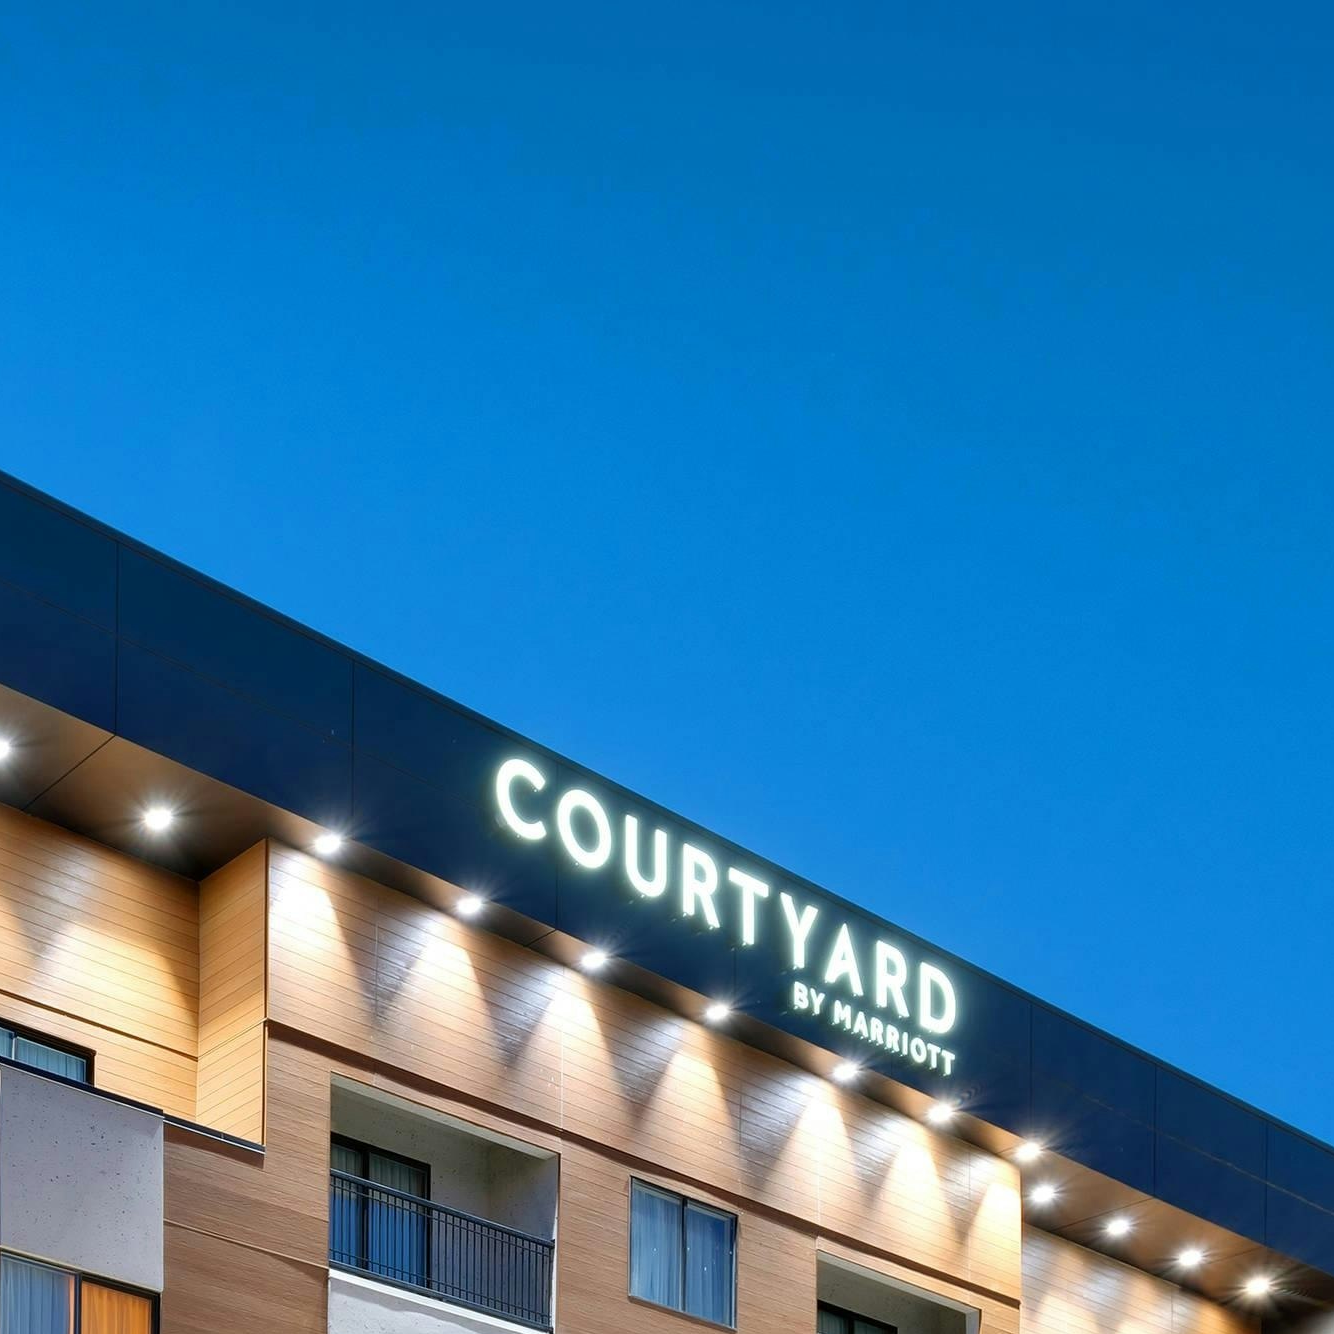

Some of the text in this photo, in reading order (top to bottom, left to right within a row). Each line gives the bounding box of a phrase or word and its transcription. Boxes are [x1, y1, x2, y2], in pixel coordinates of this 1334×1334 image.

[495, 758, 957, 1034] COURTYARD
[793, 981, 955, 1076] BY MARRIOTT
